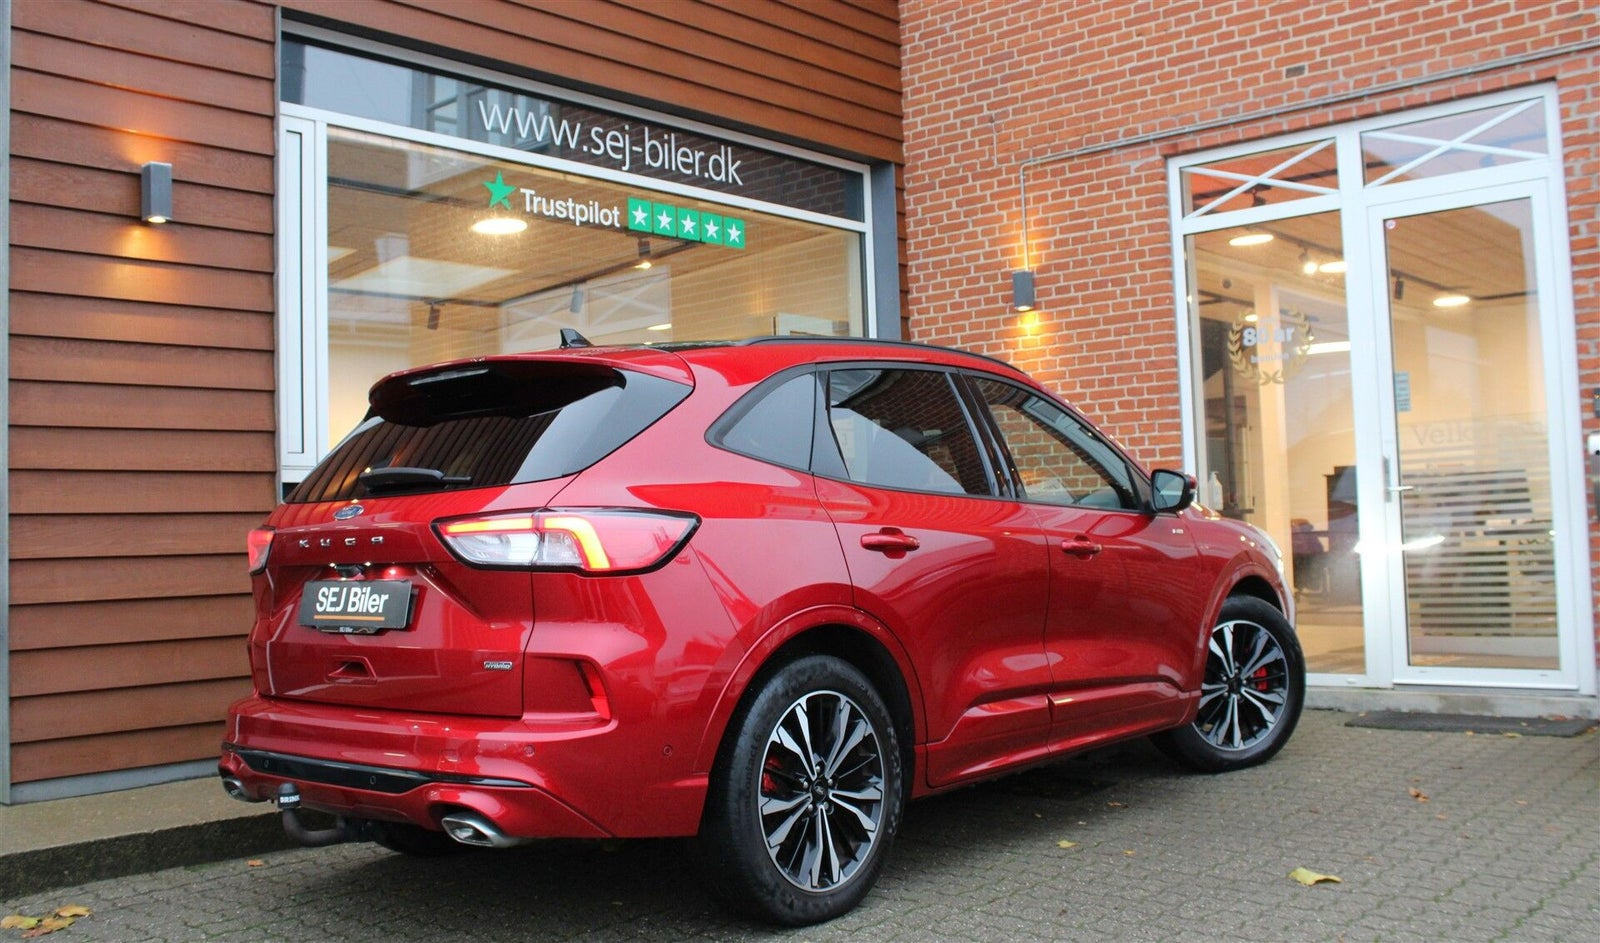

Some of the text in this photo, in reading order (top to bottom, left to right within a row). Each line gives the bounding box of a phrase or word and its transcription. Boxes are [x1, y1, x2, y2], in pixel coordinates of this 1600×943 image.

[478, 99, 744, 187] www.sej-biler.dk
[520, 187, 621, 229] Trustpilot
[298, 536, 384, 549] KUGA
[316, 587, 390, 613] SEJ Biler
[485, 662, 511, 670] HYBRID
